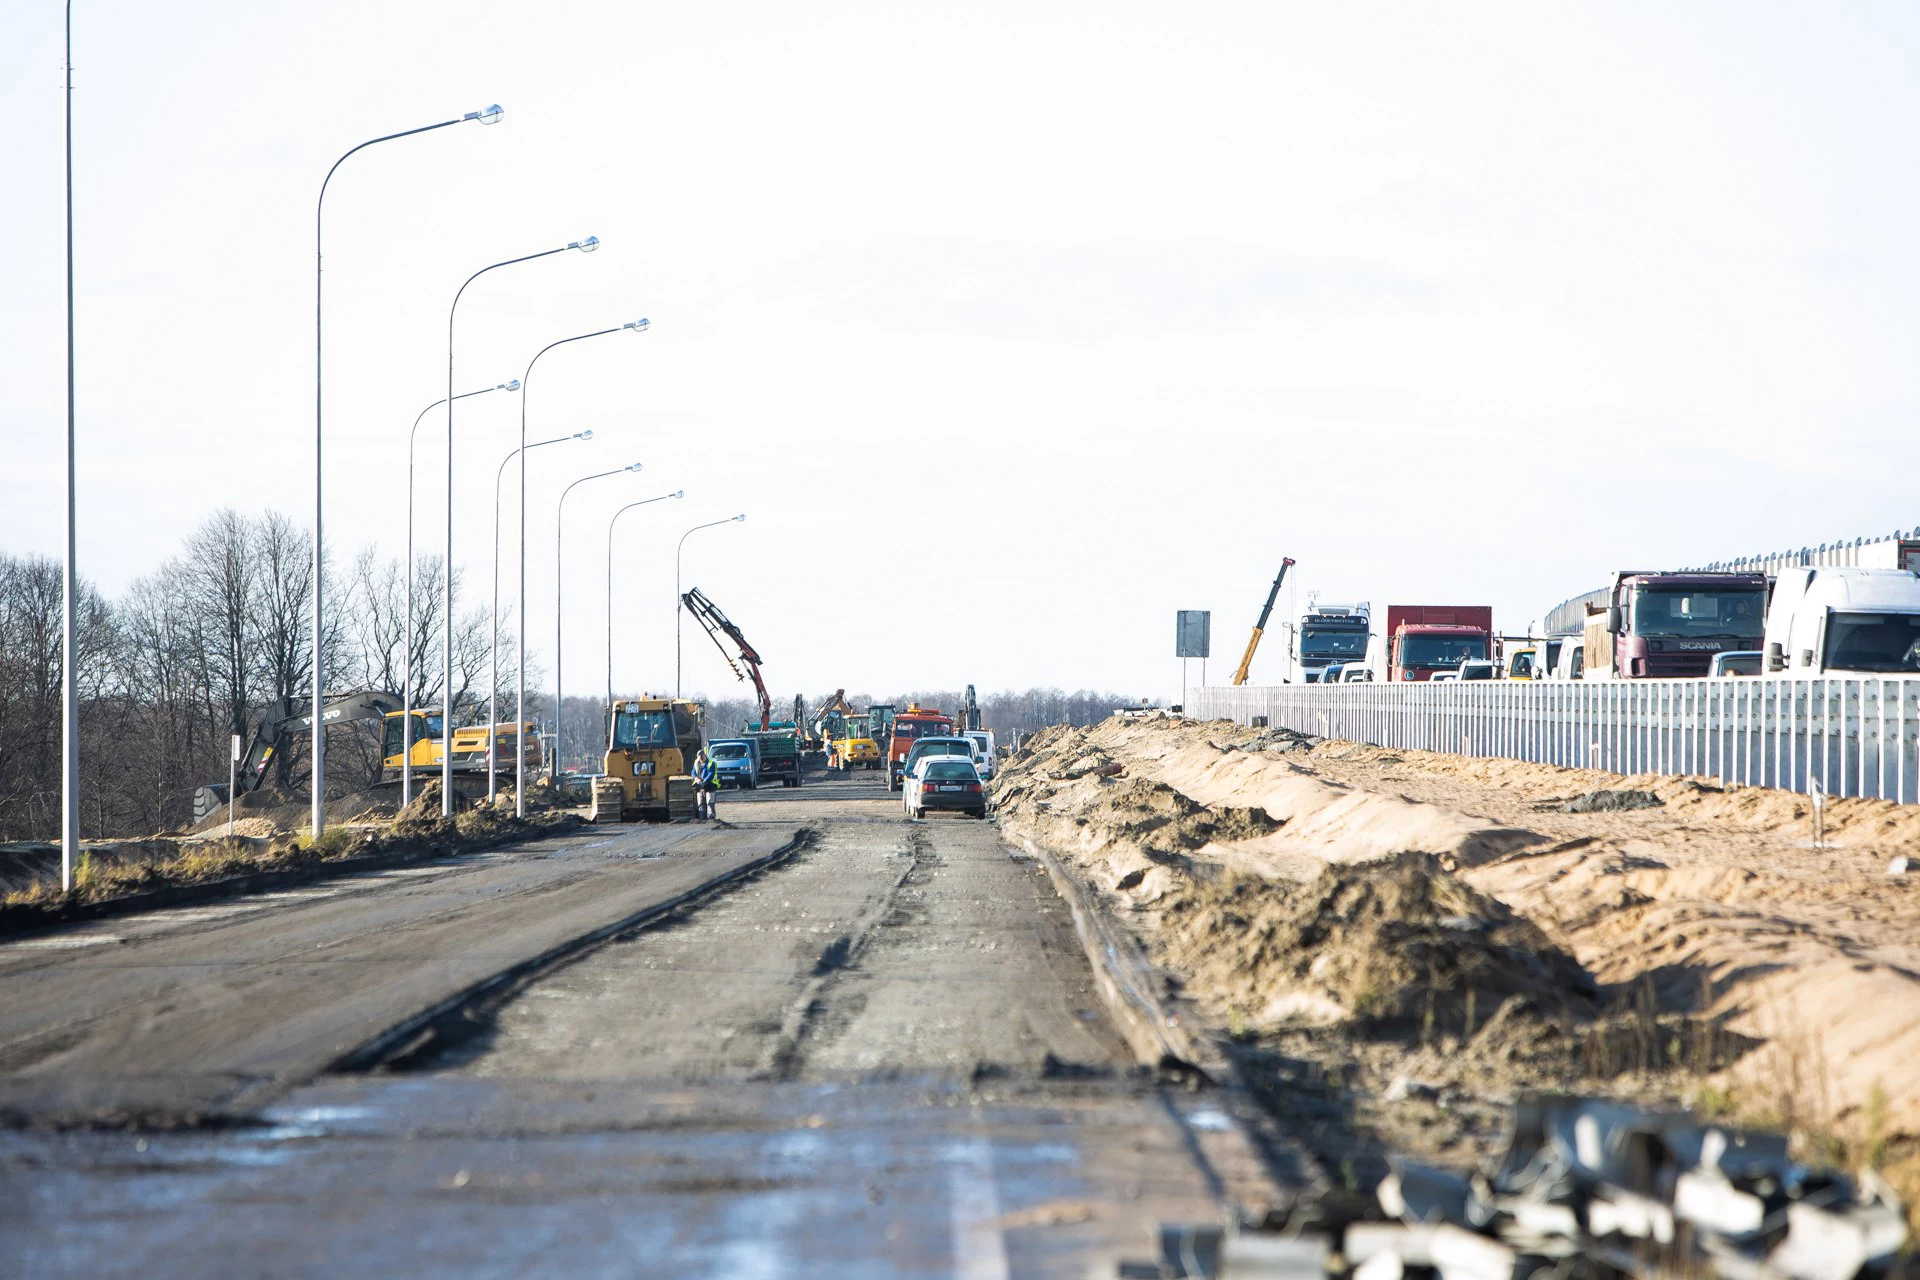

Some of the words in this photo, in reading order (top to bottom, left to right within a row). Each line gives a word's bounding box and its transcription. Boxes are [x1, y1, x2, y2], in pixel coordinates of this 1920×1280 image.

[1679, 642, 1722, 650] SCANIA
[302, 709, 341, 725] VVO
[633, 762, 655, 775] CAT
